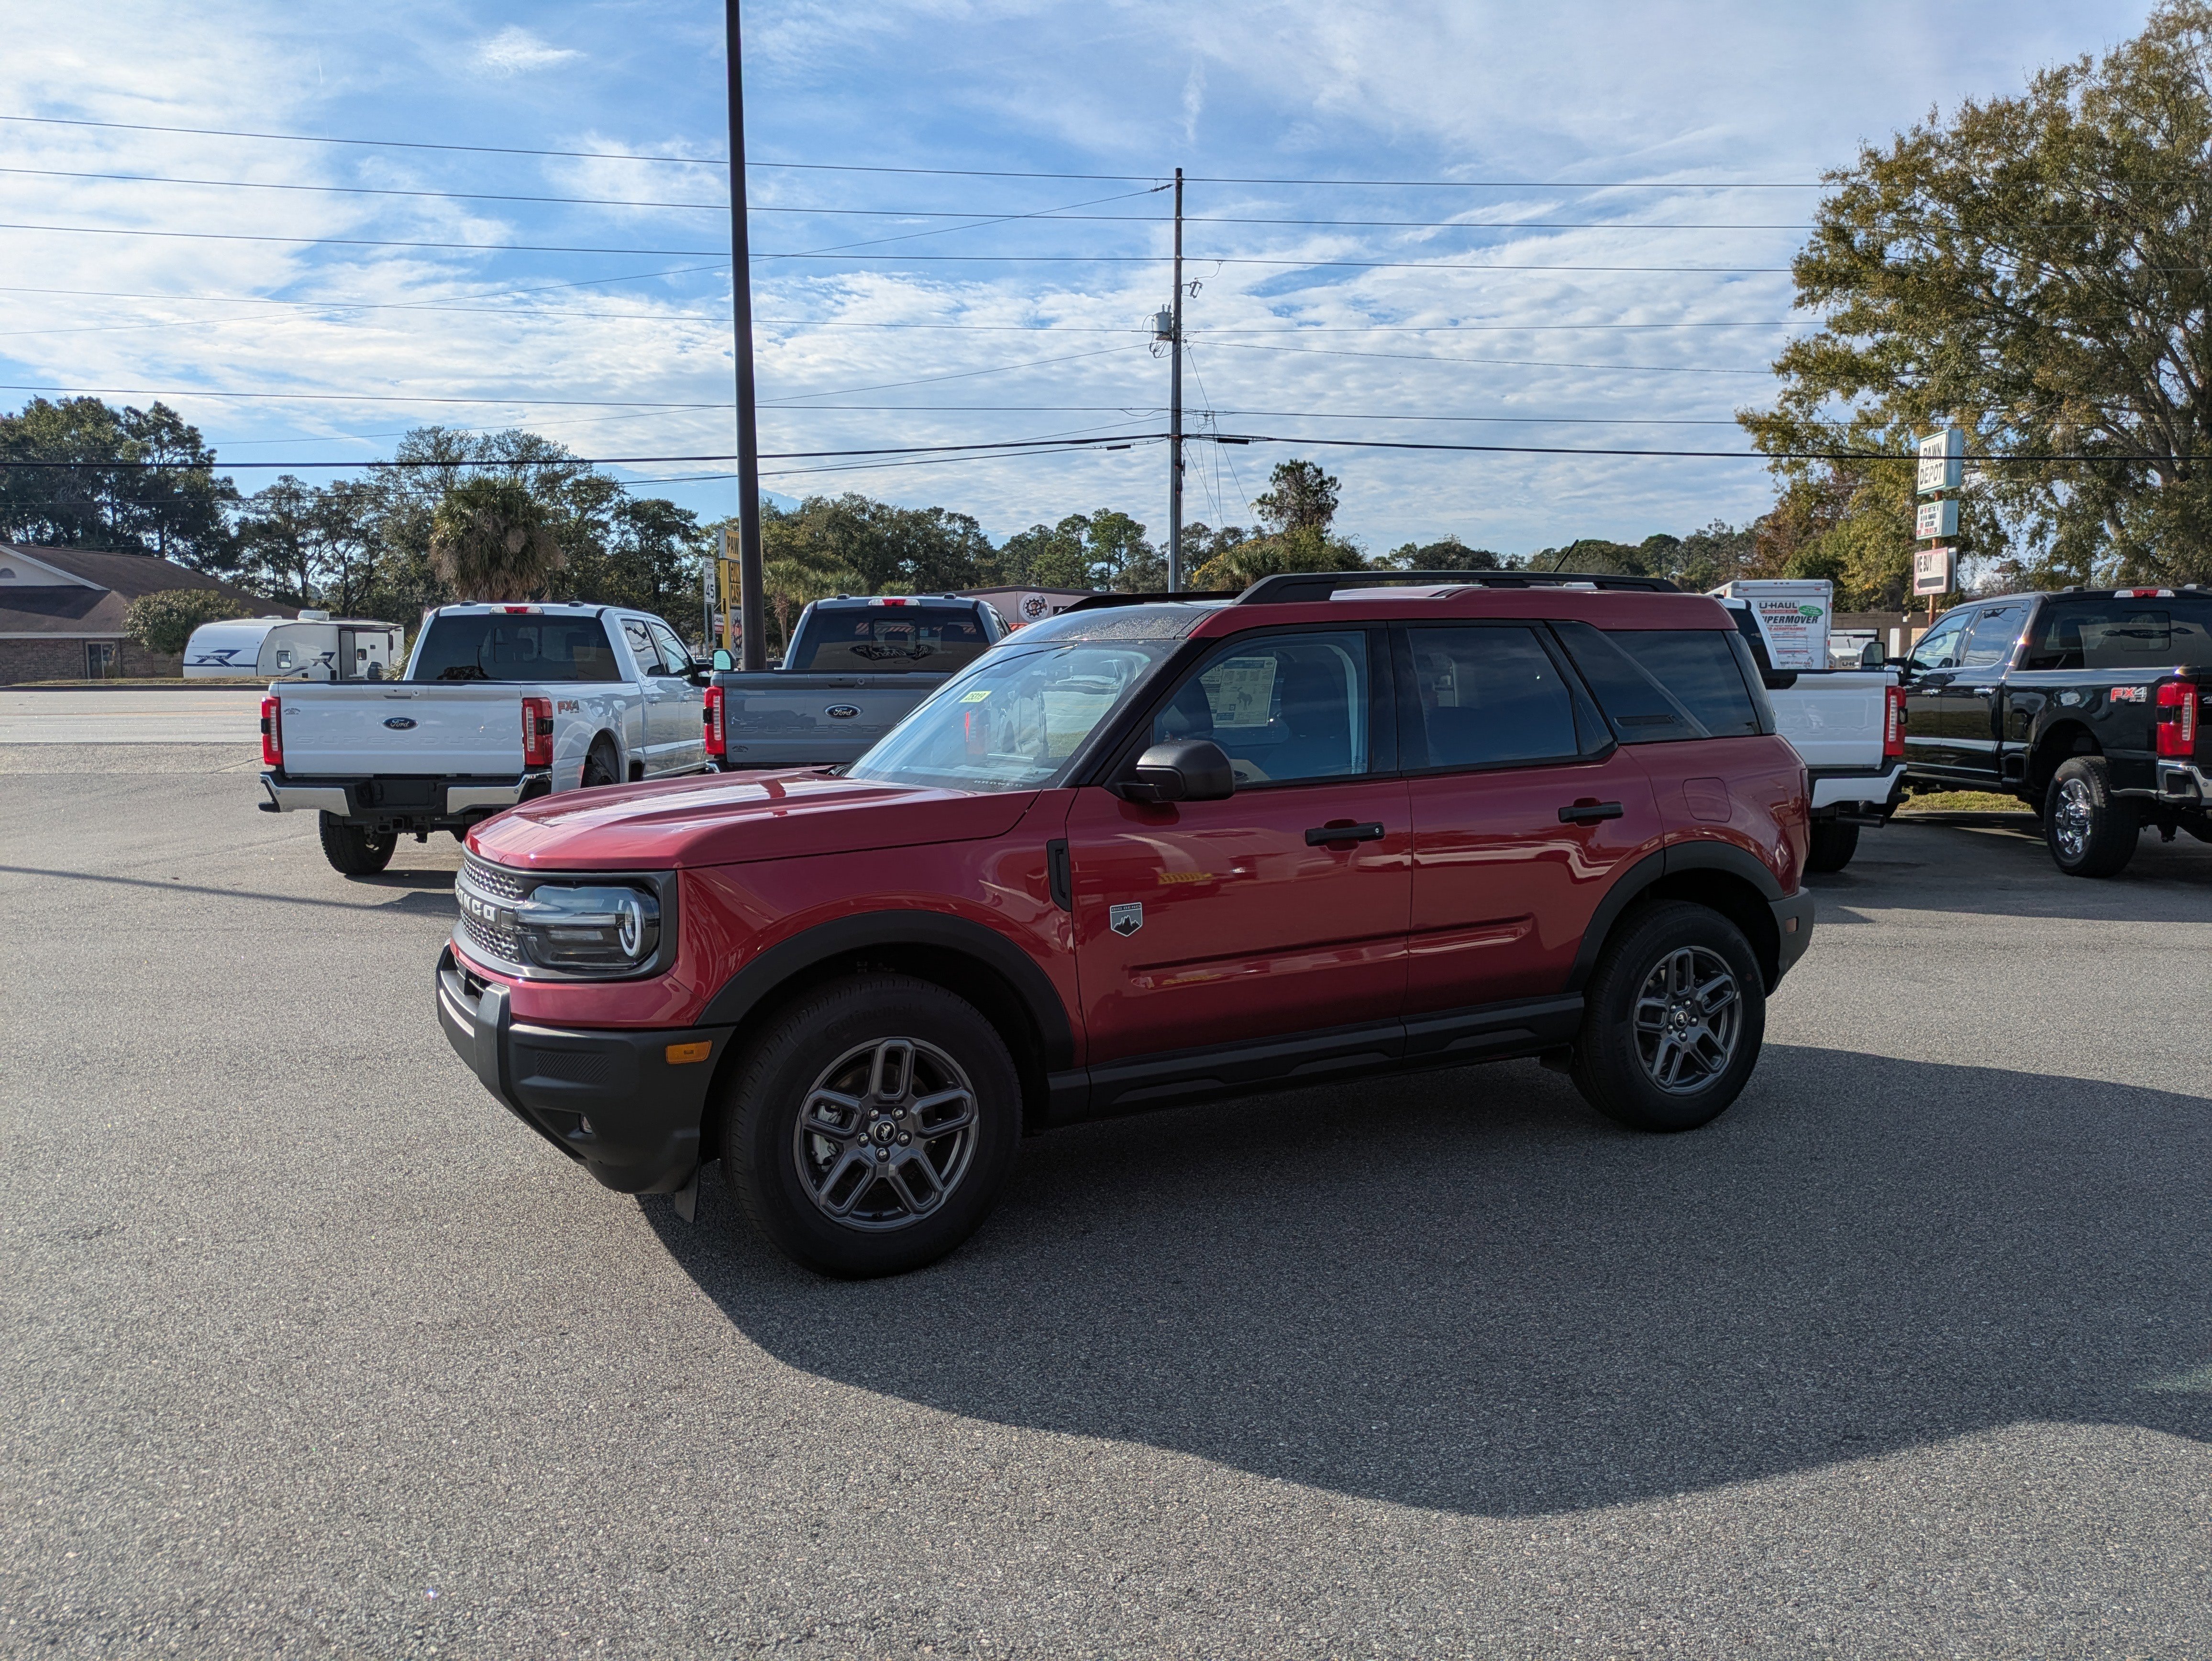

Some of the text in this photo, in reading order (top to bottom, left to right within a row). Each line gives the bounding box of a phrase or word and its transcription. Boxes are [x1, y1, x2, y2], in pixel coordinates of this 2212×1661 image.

[1922, 442, 1942, 465] PAWN
[1920, 462, 1943, 485] DEPOT
[727, 535, 739, 554] PAW
[1916, 554, 1933, 573] WE BUY
[706, 584, 715, 599] 45
[1762, 616, 1819, 624] UPERMOVER
[2110, 687, 2147, 702] FX4
[557, 700, 579, 714] FX4
[833, 708, 852, 716] Ford
[390, 719, 409, 728] Ford
[296, 736, 509, 745] SUPER DUTY
[455, 878, 497, 922] ONCO
